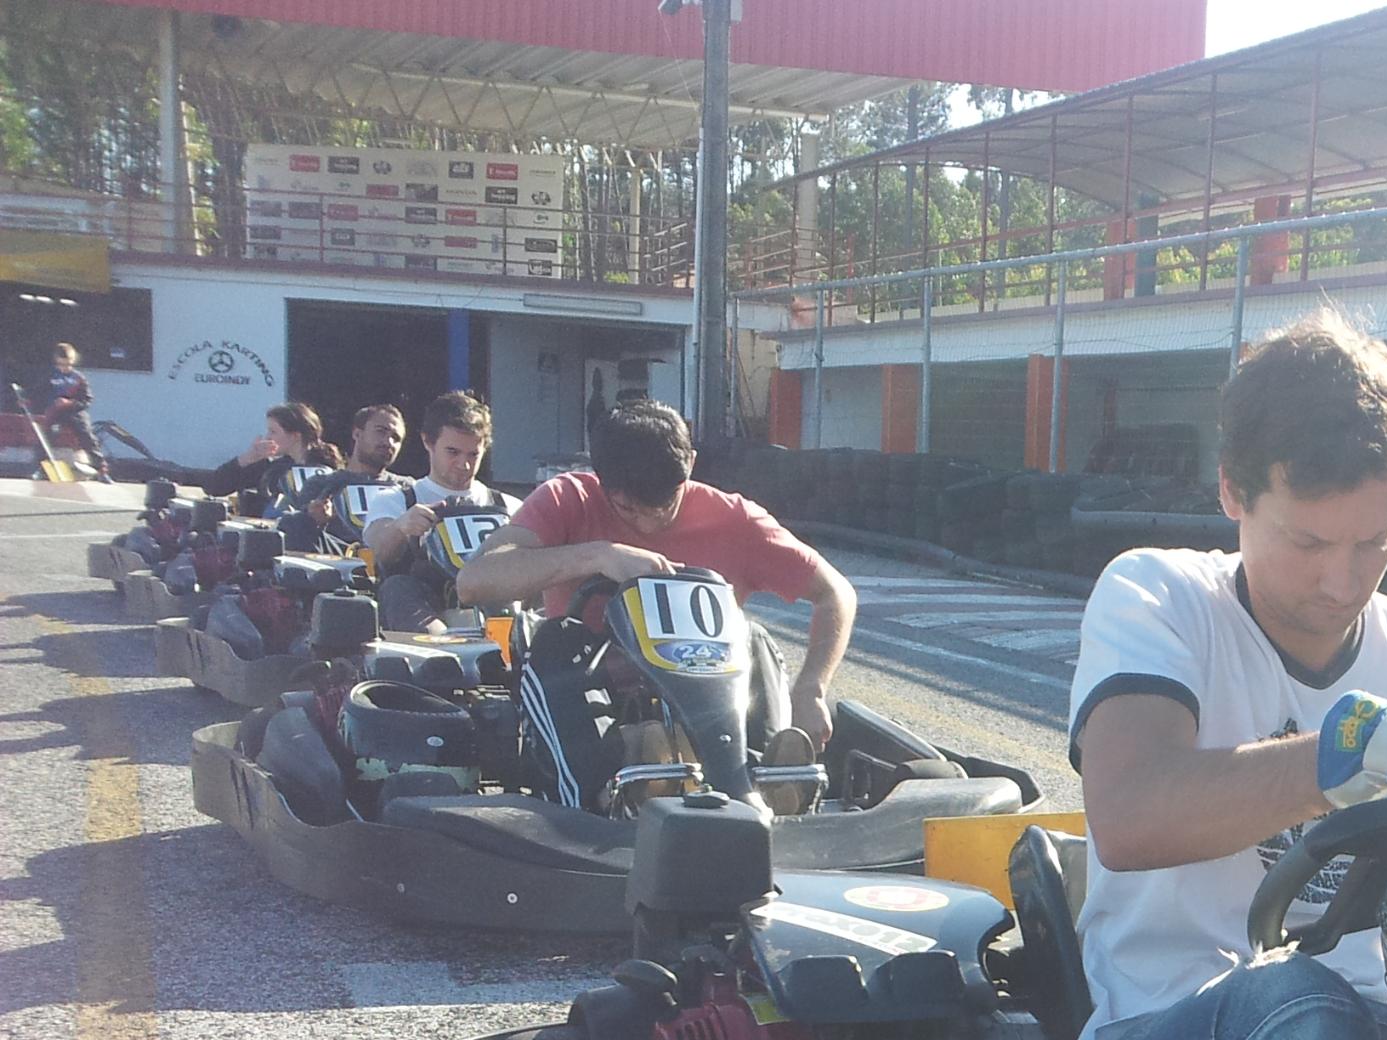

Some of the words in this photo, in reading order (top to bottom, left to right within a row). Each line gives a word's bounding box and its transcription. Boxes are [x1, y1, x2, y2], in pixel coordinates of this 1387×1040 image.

[222, 340, 274, 387] KARTING
[654, 583, 724, 638] 10
[680, 645, 712, 659] 24
